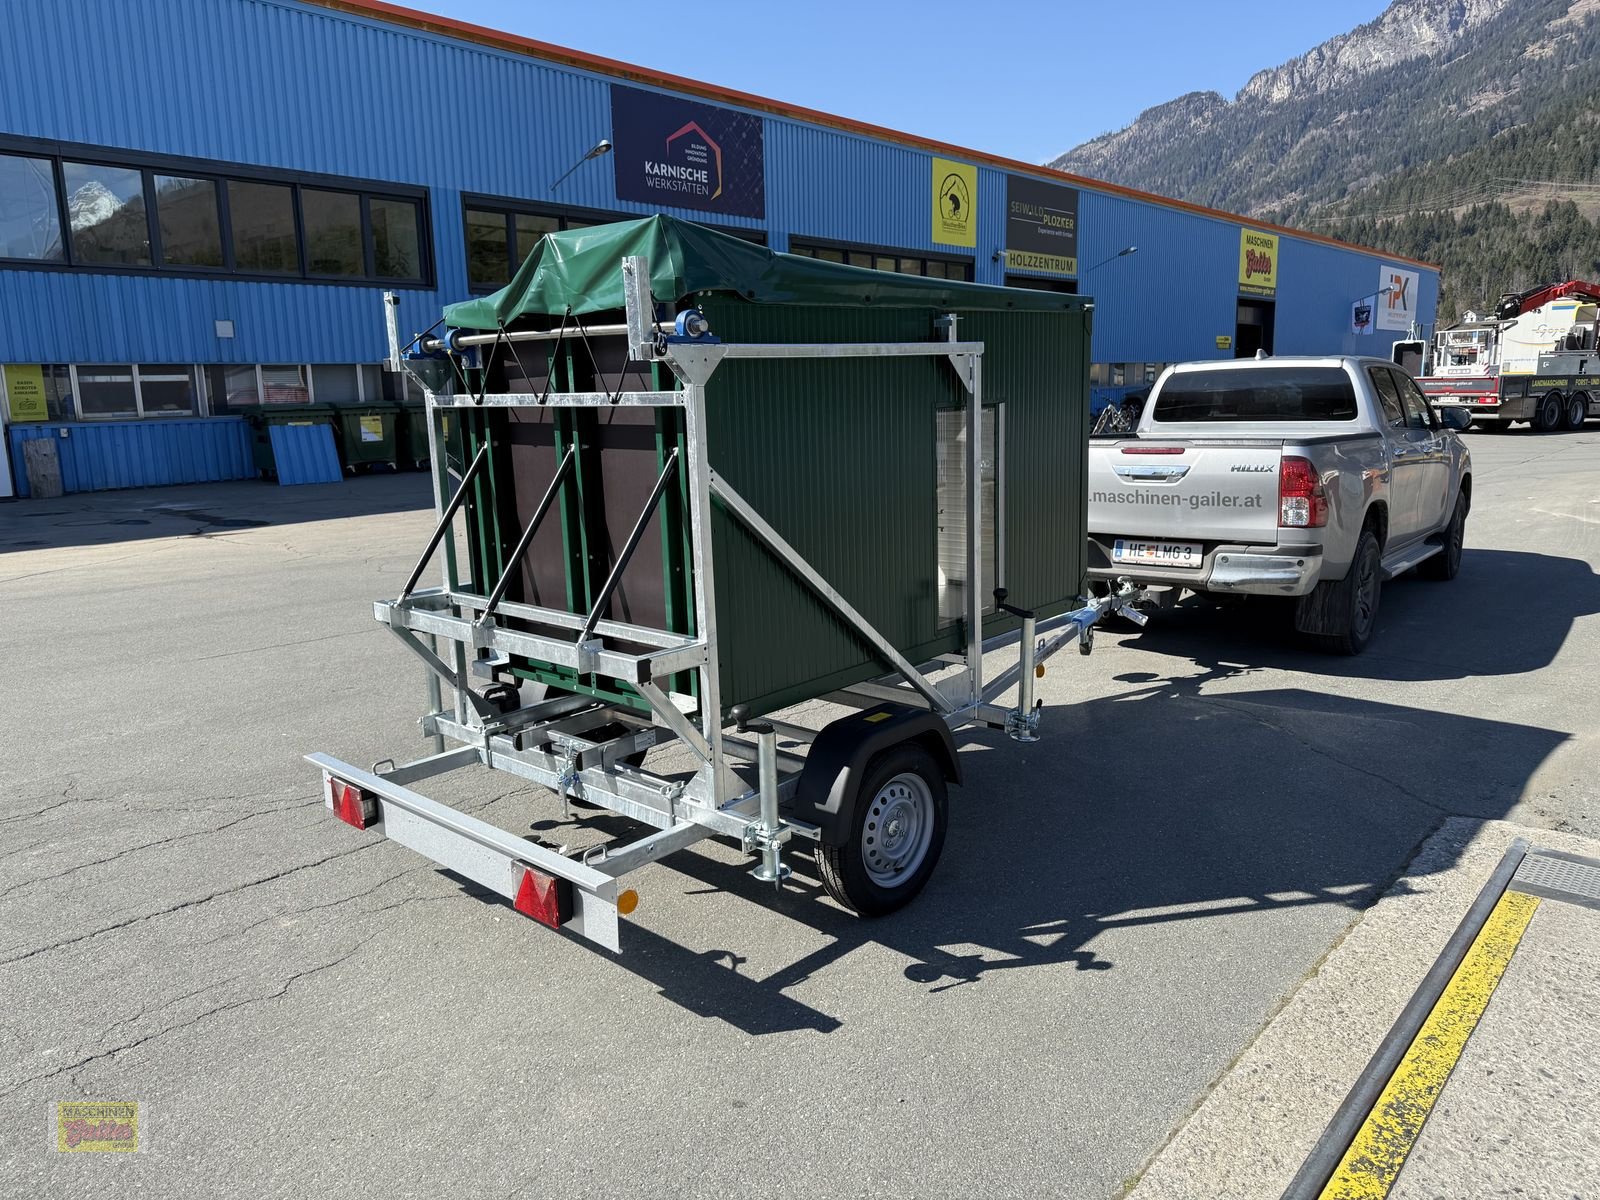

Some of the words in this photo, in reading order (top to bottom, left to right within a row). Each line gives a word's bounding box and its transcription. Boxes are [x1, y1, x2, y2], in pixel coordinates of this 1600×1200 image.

[645, 161, 708, 183] KARNISCHE
[646, 176, 709, 195] WERKSTÄTTEN
[1246, 235, 1274, 249] MASCHINEN
[1009, 252, 1073, 272] HOLZZENTRUM
[1231, 464, 1275, 472] HILUX
[1130, 544, 1145, 557] HE
[1155, 545, 1180, 560] LMG
[1184, 547, 1192, 560] 3
